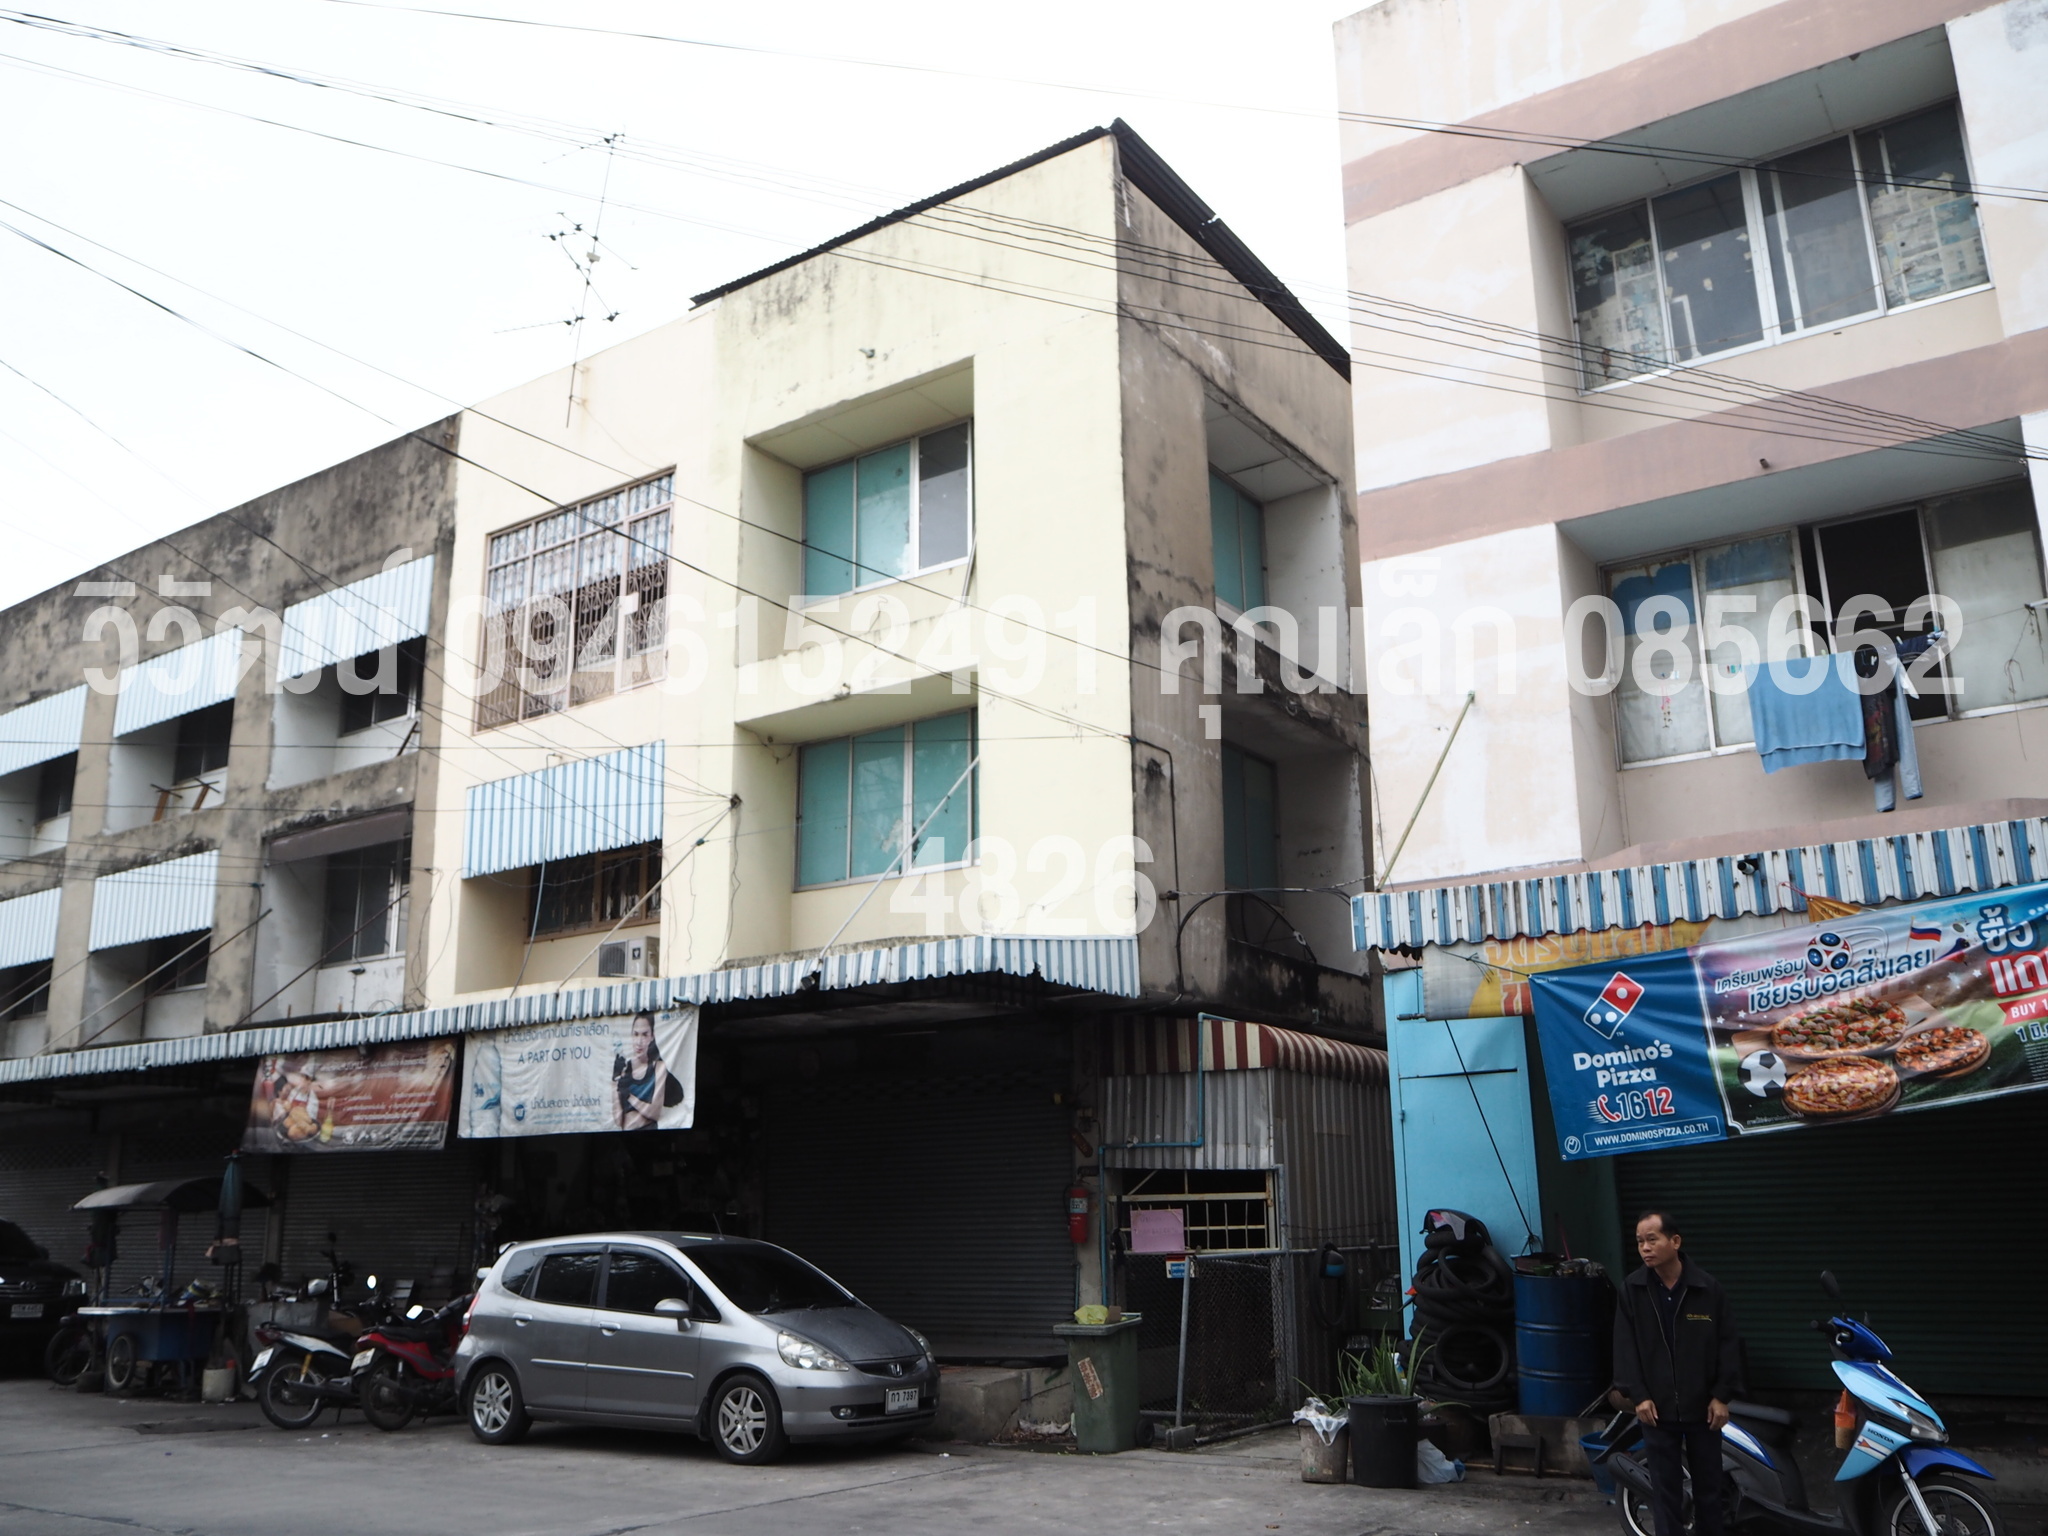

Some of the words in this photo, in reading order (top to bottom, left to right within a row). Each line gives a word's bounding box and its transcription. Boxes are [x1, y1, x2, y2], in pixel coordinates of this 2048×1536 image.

[1715, 958, 1806, 993] เตรียมพร้อม
[1750, 949, 1934, 1013] เชียร์บอลสั่งเลย
[1990, 951, 2048, 994] แถ
[2011, 1002, 2037, 1018] BUY
[518, 1053, 525, 1064] A
[527, 1049, 550, 1063] PART
[552, 1048, 567, 1061] OF
[569, 1046, 591, 1060] YOU
[1573, 1040, 1673, 1071] Domino's
[1596, 1067, 1657, 1088] Pizza
[1616, 1087, 1675, 1121] 1612
[1594, 1123, 1709, 1146] WWW.DOMINOSPIZZA.CO.TH
[1867, 1428, 1895, 1445] HONDA
